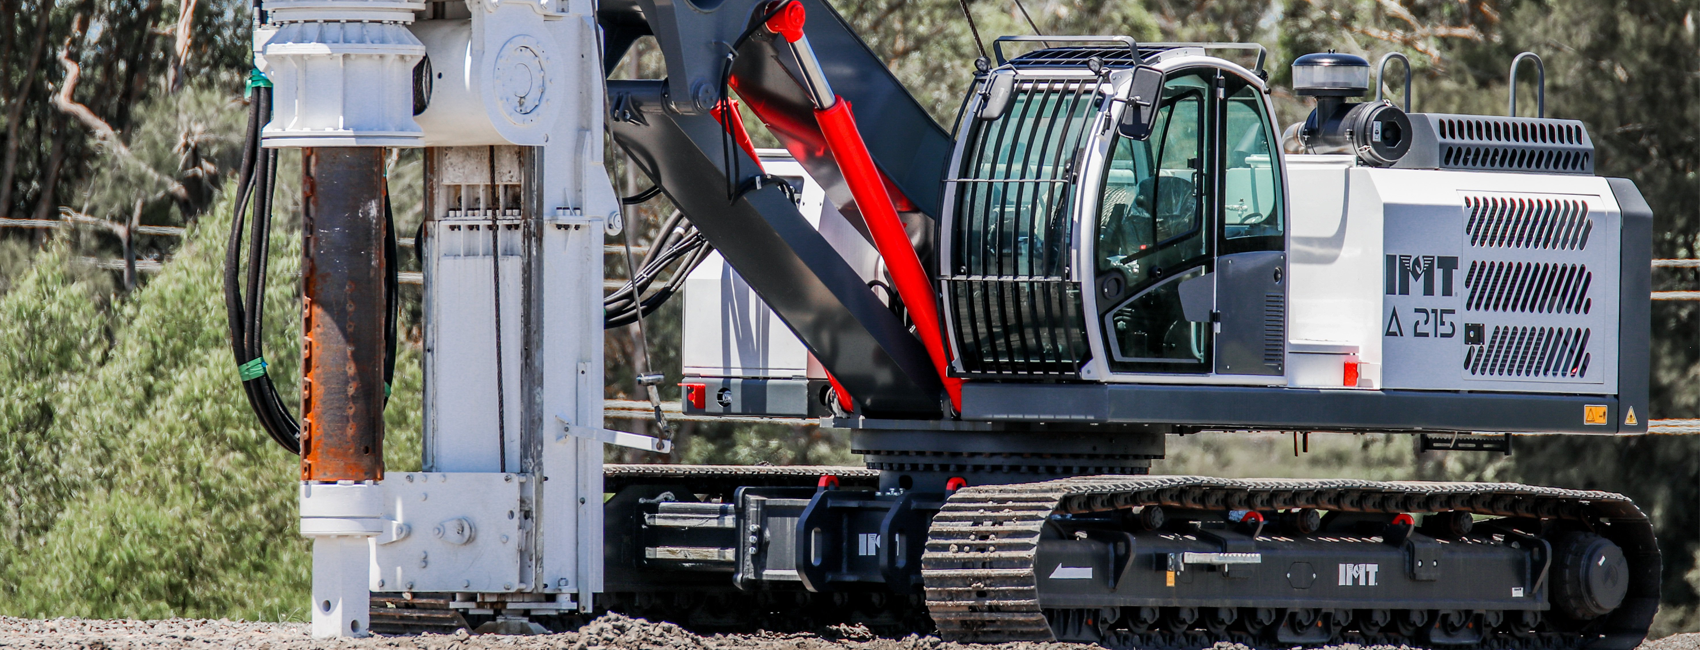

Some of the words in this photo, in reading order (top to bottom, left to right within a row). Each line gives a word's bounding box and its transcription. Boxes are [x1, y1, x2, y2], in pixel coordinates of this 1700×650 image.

[1385, 254, 1459, 297] IMT
[1413, 307, 1456, 339] 215
[858, 533, 900, 557] IM
[1338, 563, 1379, 586] IMT
